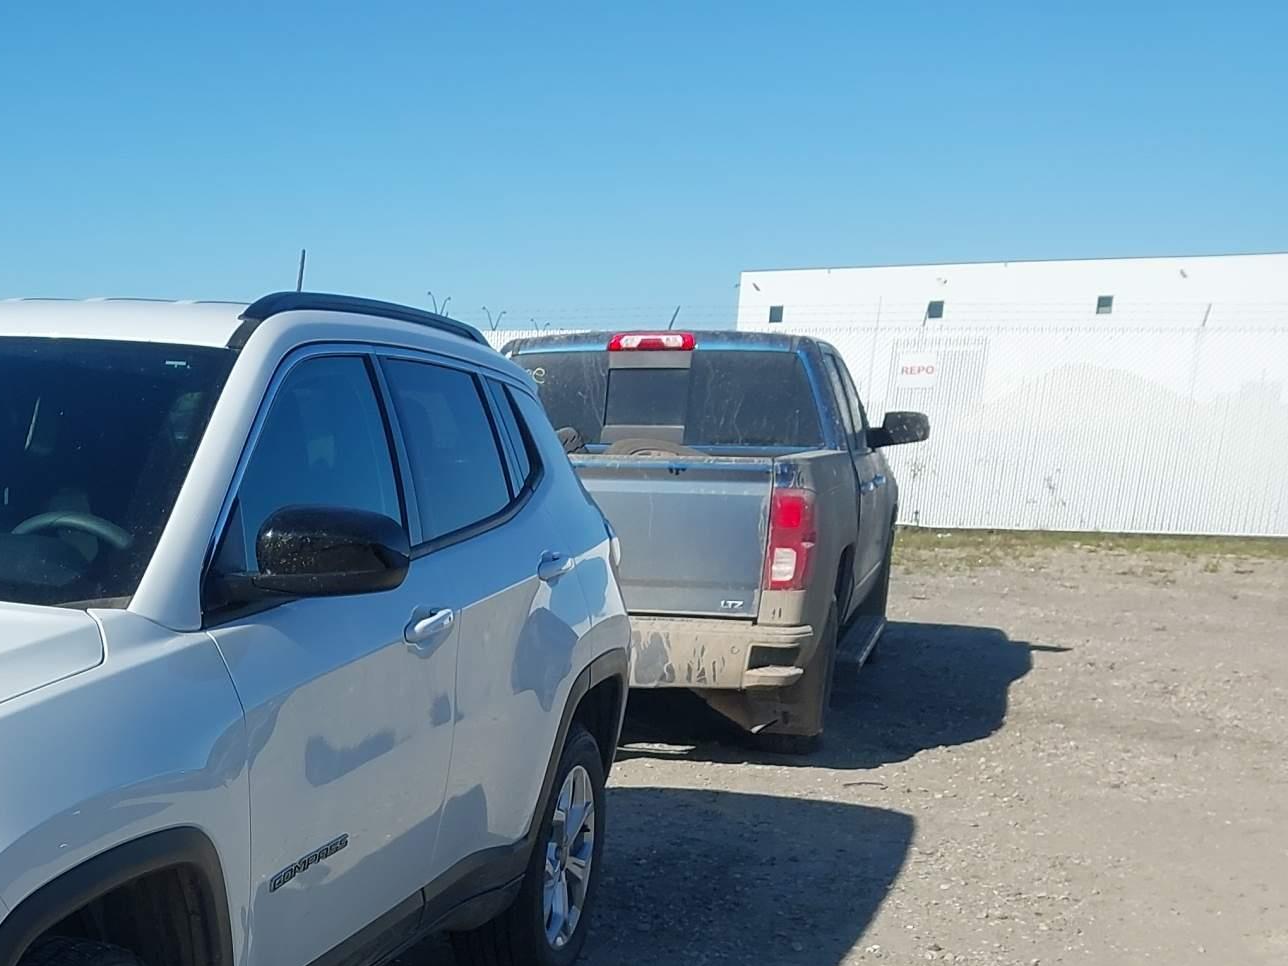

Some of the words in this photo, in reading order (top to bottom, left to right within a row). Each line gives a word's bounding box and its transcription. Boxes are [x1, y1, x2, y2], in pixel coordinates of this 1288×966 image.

[900, 365, 935, 376] REPO
[720, 599, 744, 609] LTZ
[269, 832, 349, 893] COMPASS
